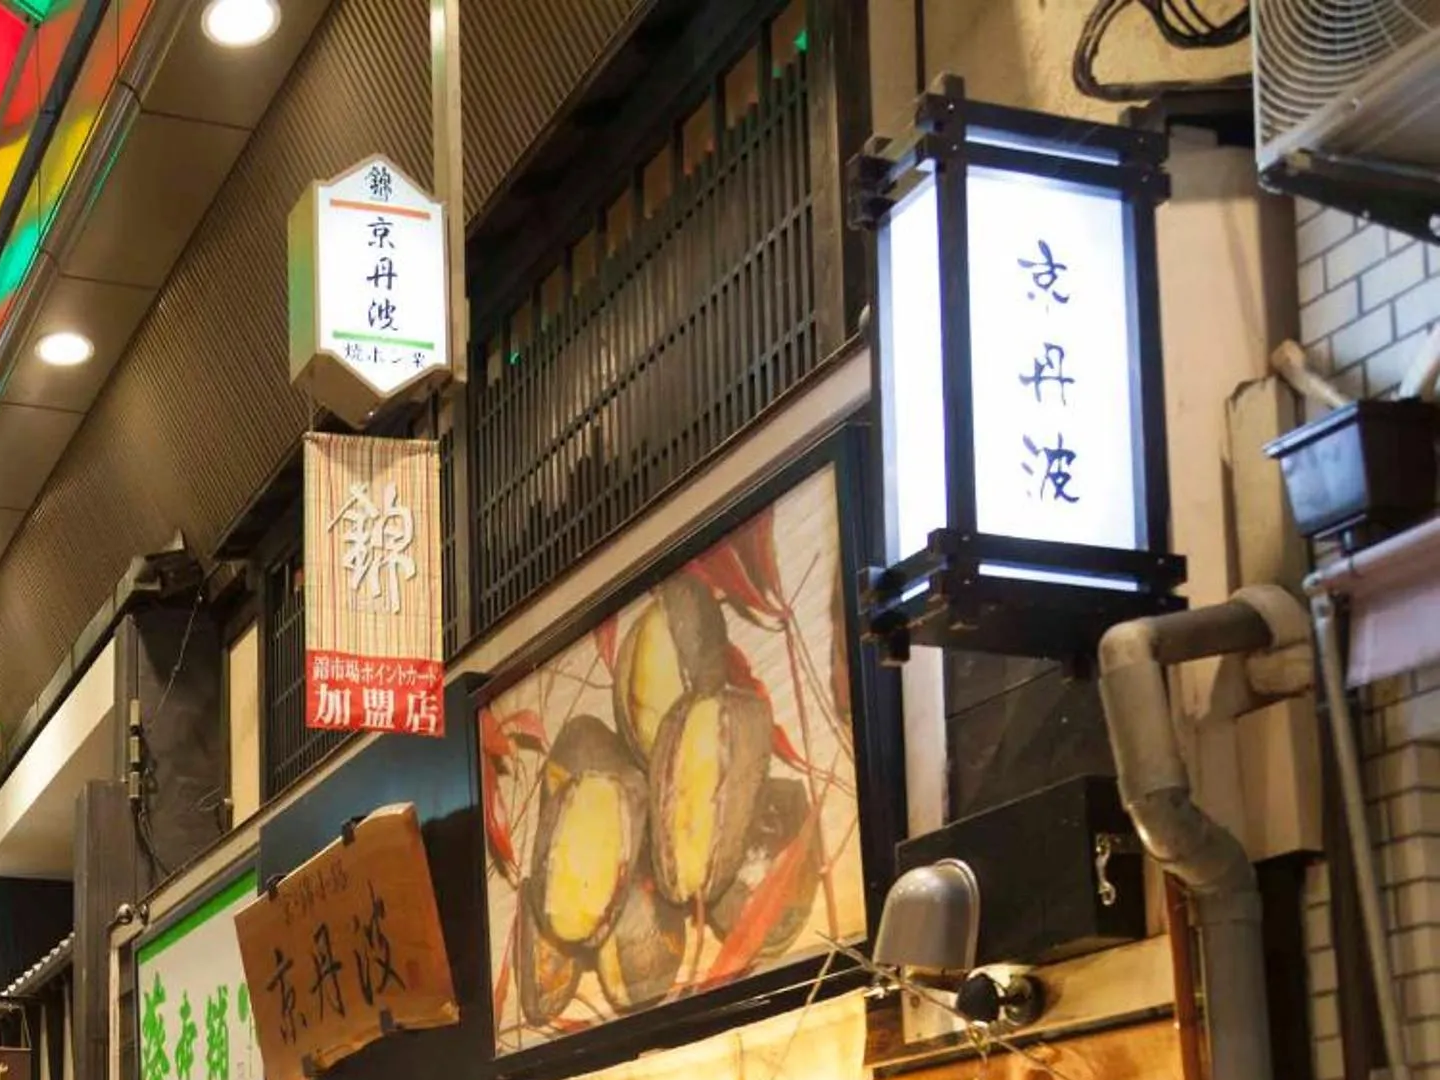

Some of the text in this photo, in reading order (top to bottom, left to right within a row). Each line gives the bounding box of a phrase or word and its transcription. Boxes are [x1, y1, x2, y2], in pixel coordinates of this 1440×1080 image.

[366, 217, 399, 331] 京丹波
[1017, 239, 1080, 503] 京丹波
[328, 481, 416, 615] 錦
[313, 656, 437, 688] 錦市場ポイントカード
[313, 683, 438, 733] 加盟店
[266, 877, 406, 1044] 京丹波
